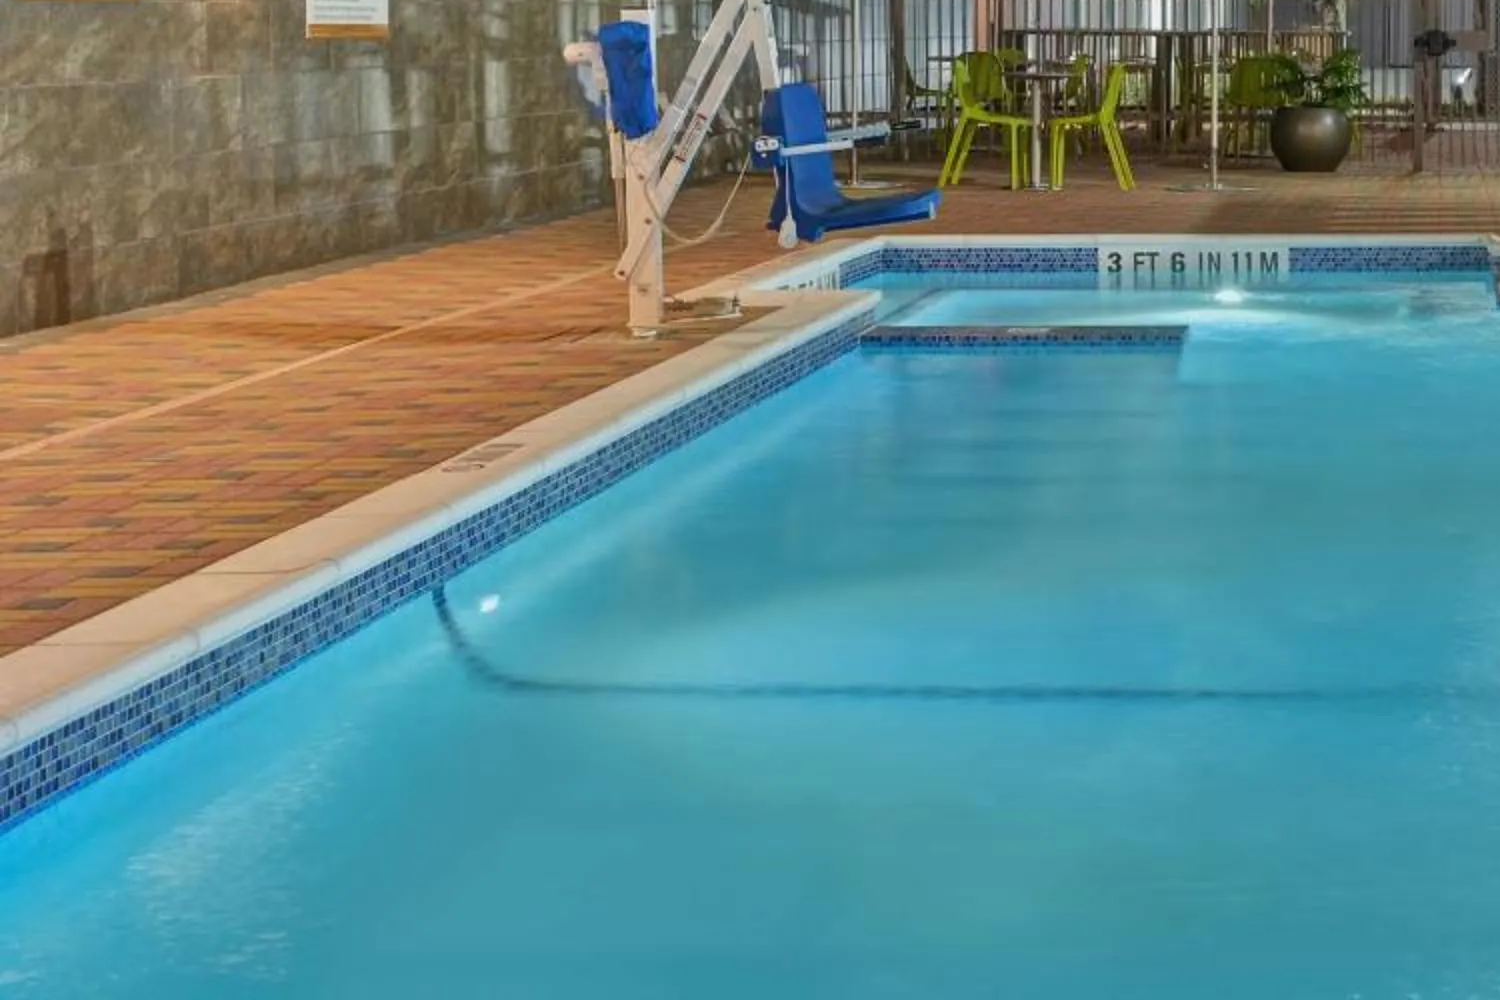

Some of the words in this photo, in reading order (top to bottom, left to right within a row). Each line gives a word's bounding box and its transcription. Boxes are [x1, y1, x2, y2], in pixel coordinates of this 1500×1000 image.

[1107, 252, 1122, 273] 3
[1133, 252, 1160, 272] FT
[1170, 252, 1185, 273] 6
[1199, 252, 1221, 273] IN
